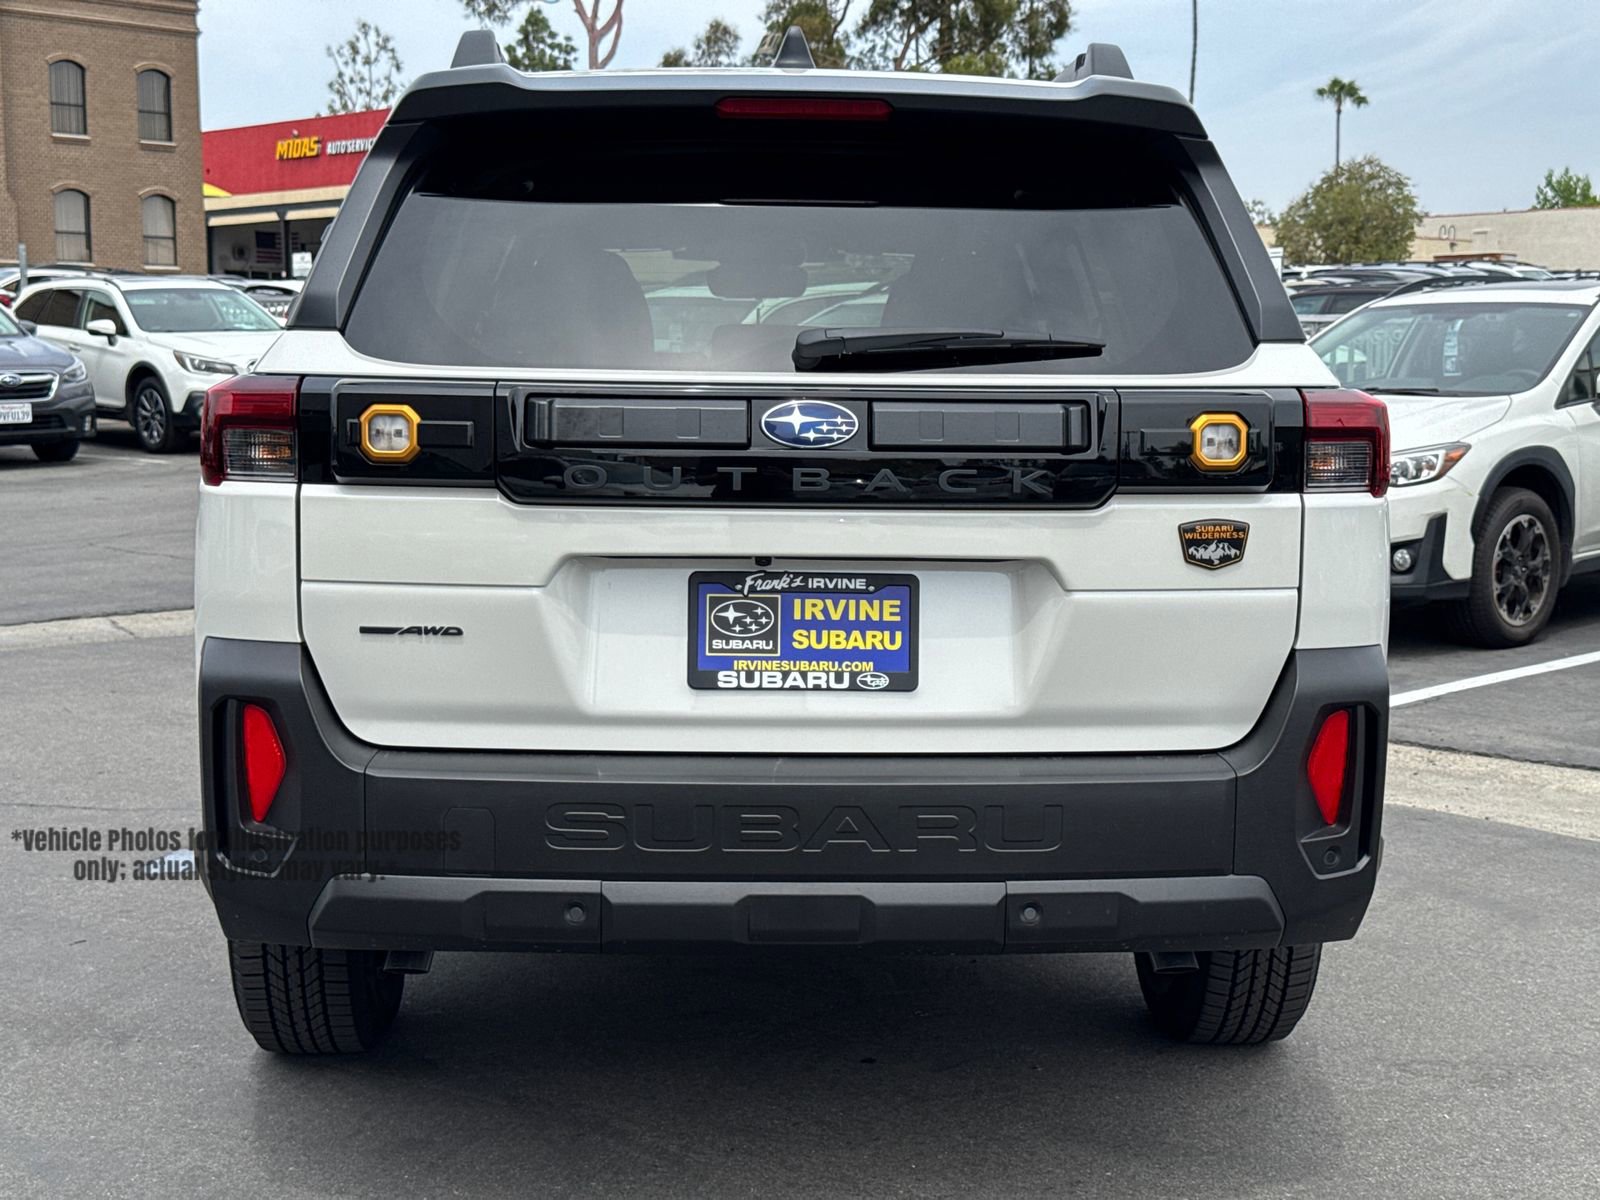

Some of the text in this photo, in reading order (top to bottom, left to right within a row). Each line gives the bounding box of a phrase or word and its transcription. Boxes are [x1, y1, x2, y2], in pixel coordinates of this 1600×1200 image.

[276, 137, 319, 160] MIDAS
[564, 466, 1054, 495] OUTBACK
[1184, 532, 1245, 540] WILDERNESS
[1195, 525, 1234, 533] SUBARU
[743, 572, 866, 597] Frank's IRVINE
[793, 599, 901, 621] IRVINE
[712, 640, 774, 650] SUBARU
[792, 630, 902, 650] SUBARU
[733, 660, 874, 672] IRVINESUBARU.COM
[717, 671, 850, 689] SUBARU
[544, 802, 1064, 852] SUBARU
